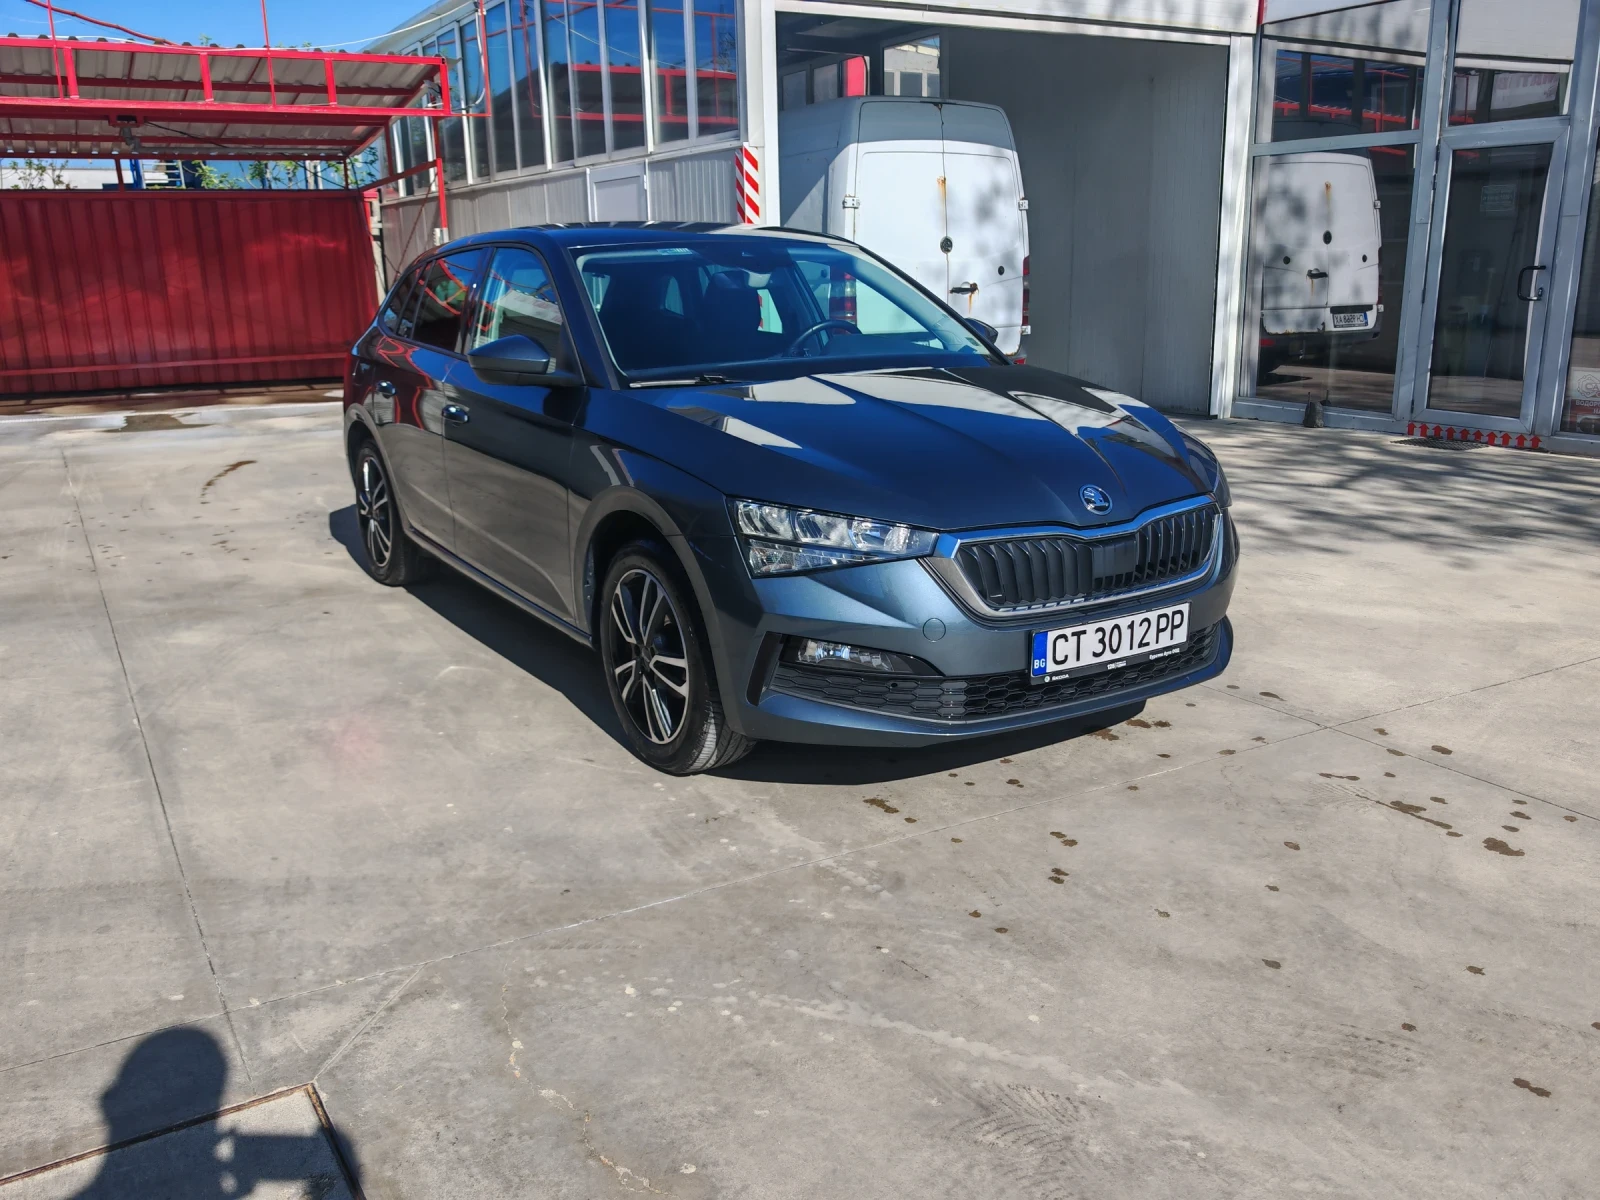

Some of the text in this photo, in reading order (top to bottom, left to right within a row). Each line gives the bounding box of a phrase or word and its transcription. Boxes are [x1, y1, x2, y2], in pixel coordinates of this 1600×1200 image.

[1052, 609, 1185, 665] CT 3012 PP
[1034, 658, 1046, 669] BG
